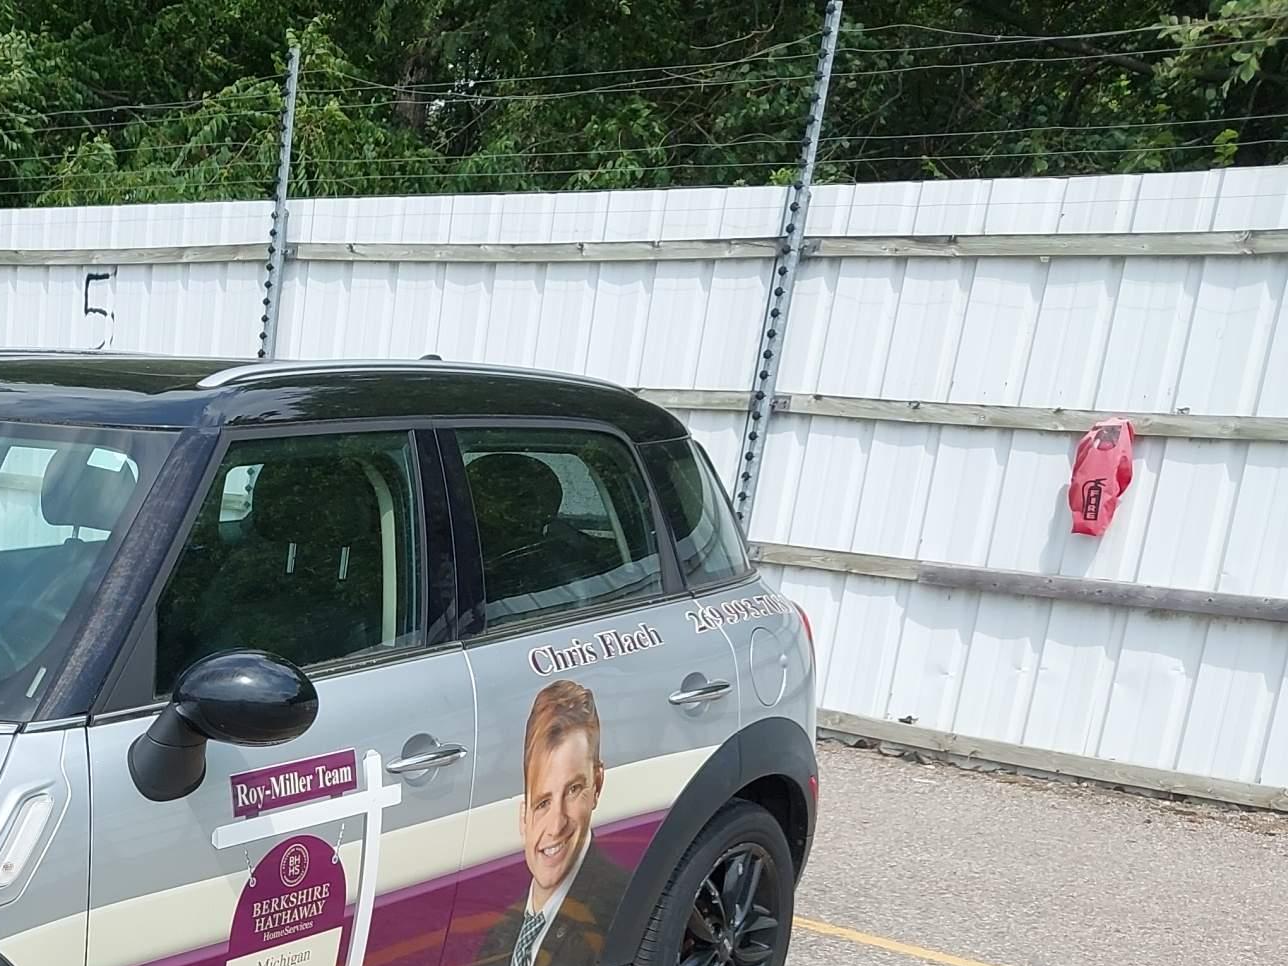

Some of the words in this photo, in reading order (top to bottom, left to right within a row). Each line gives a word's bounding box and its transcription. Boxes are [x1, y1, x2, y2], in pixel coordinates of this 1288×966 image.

[1086, 489, 1100, 519] FIRE
[528, 639, 598, 677] Chris
[596, 622, 665, 660] Flach
[236, 772, 314, 809] Roy-Miller
[315, 765, 352, 789] Team
[252, 882, 331, 918] BERKSHIRE
[254, 900, 326, 933] HATHAWAY
[263, 921, 314, 942] HomeServices
